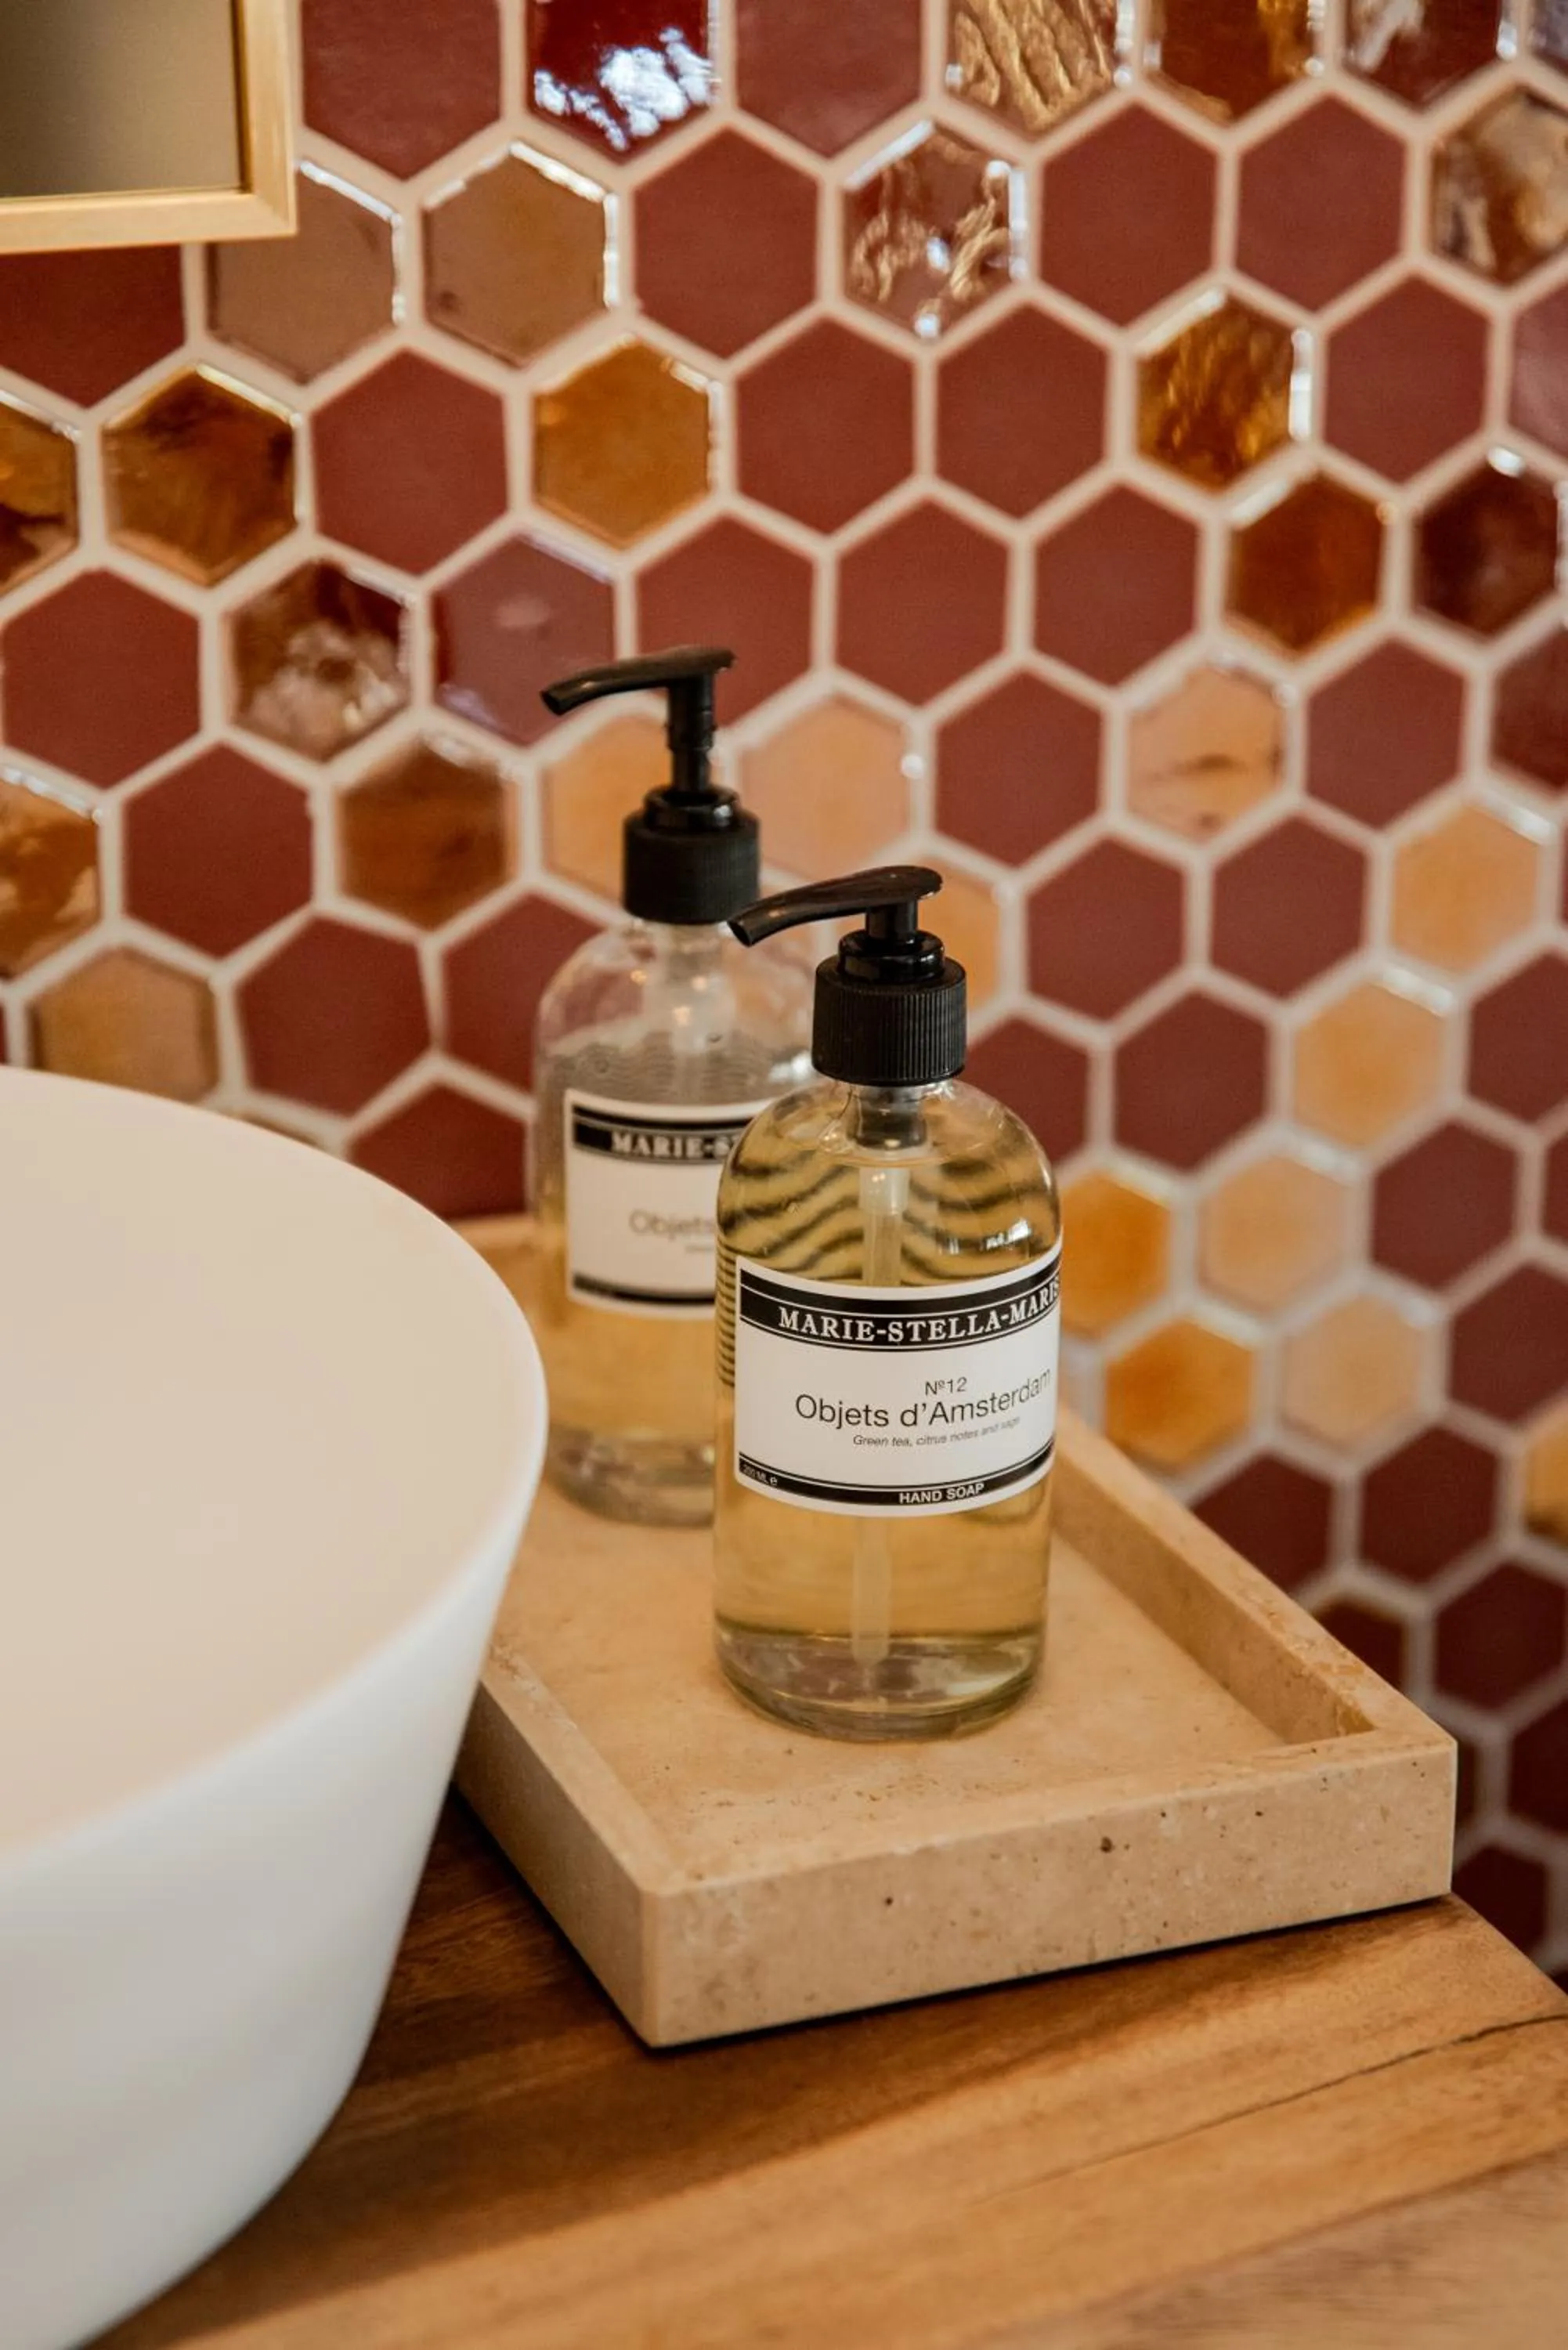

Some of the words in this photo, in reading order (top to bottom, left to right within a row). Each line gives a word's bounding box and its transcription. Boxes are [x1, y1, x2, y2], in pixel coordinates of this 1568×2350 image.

[795, 1394, 889, 1430] Objets
[853, 1434, 889, 1448] Green
[892, 1437, 913, 1448] tea,
[916, 1434, 947, 1446] citrus
[950, 1429, 979, 1442] notes
[980, 1423, 999, 1435] and
[898, 1490, 942, 1504] HAND
[946, 1483, 985, 1500] SOAP
